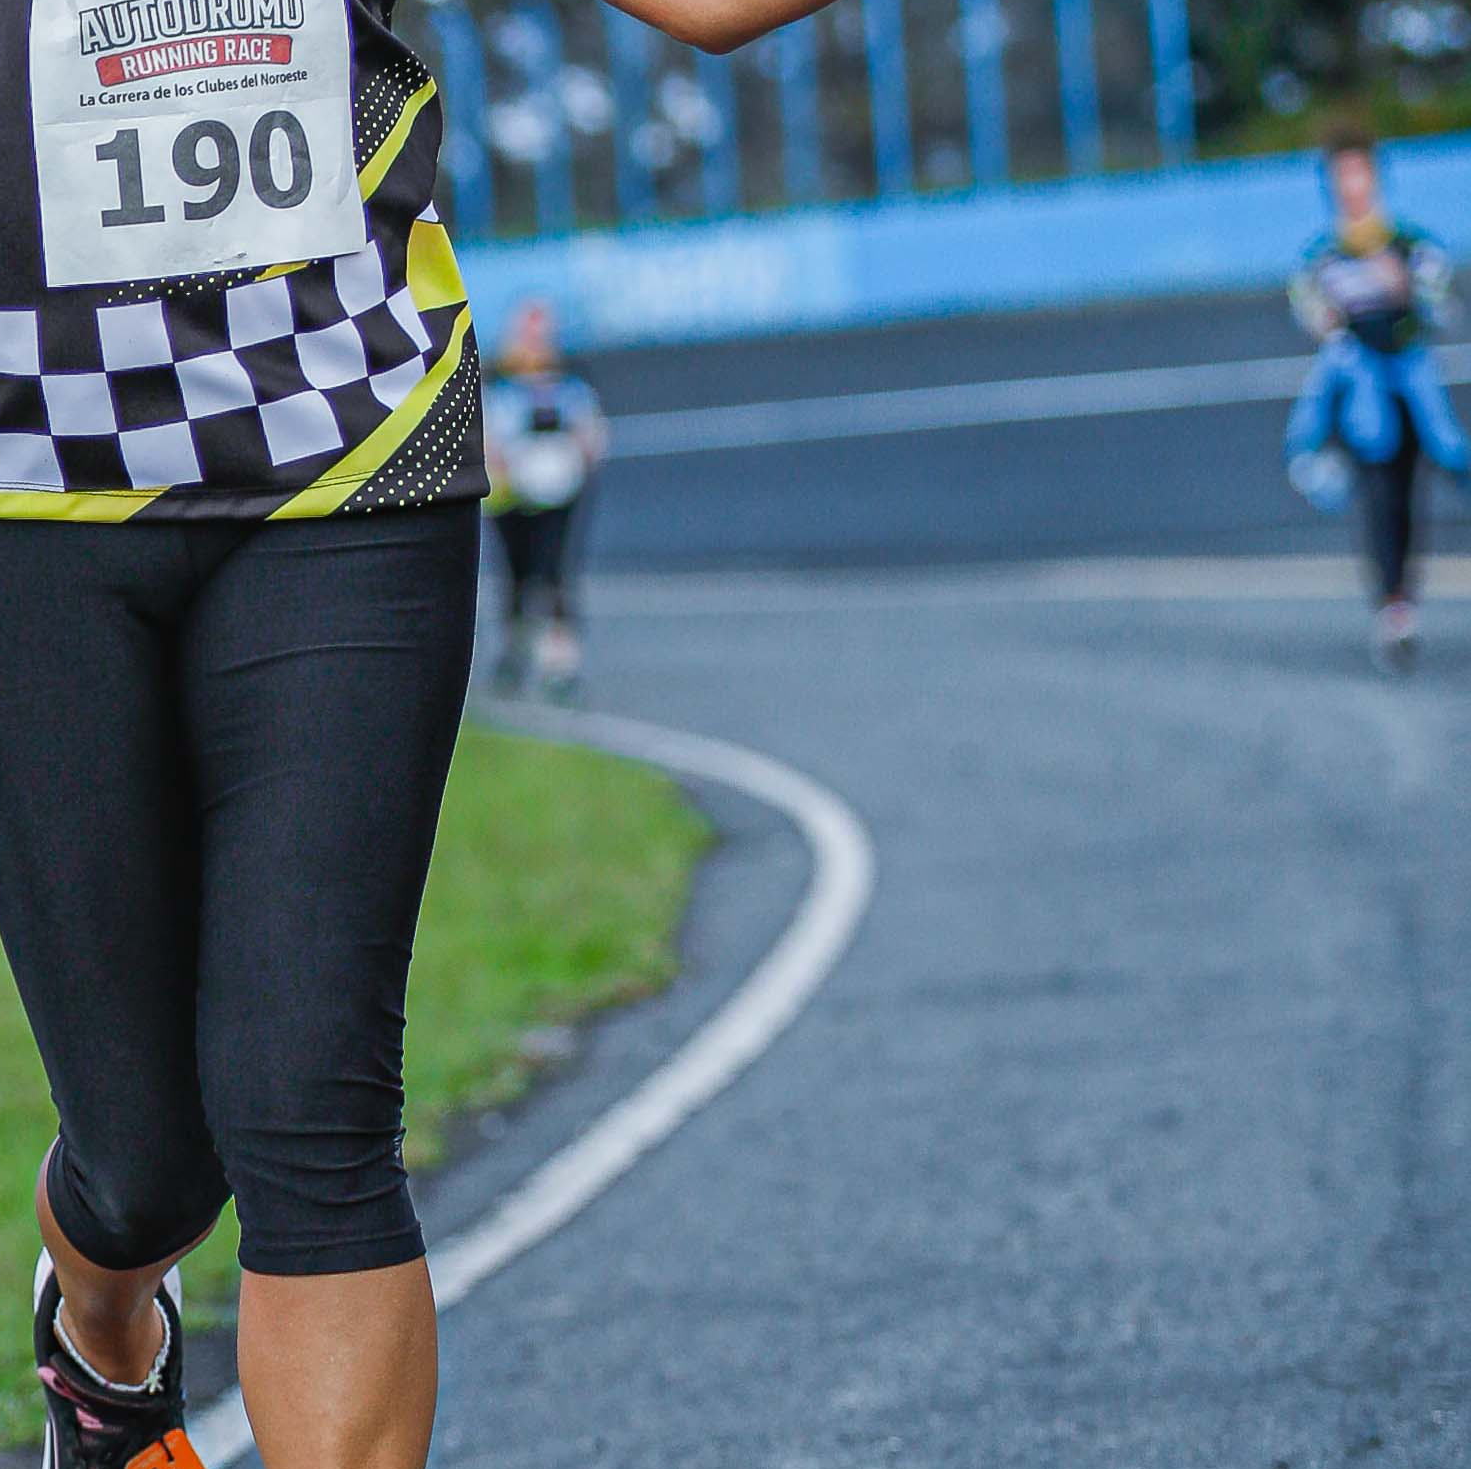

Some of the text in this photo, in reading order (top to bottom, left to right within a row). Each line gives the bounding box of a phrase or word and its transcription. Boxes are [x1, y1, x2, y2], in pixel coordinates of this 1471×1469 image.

[120, 38, 272, 79] RUNNING RACE
[80, 69, 308, 107] La Carrera de los Clubes del Noroeste
[95, 109, 313, 228] 190
